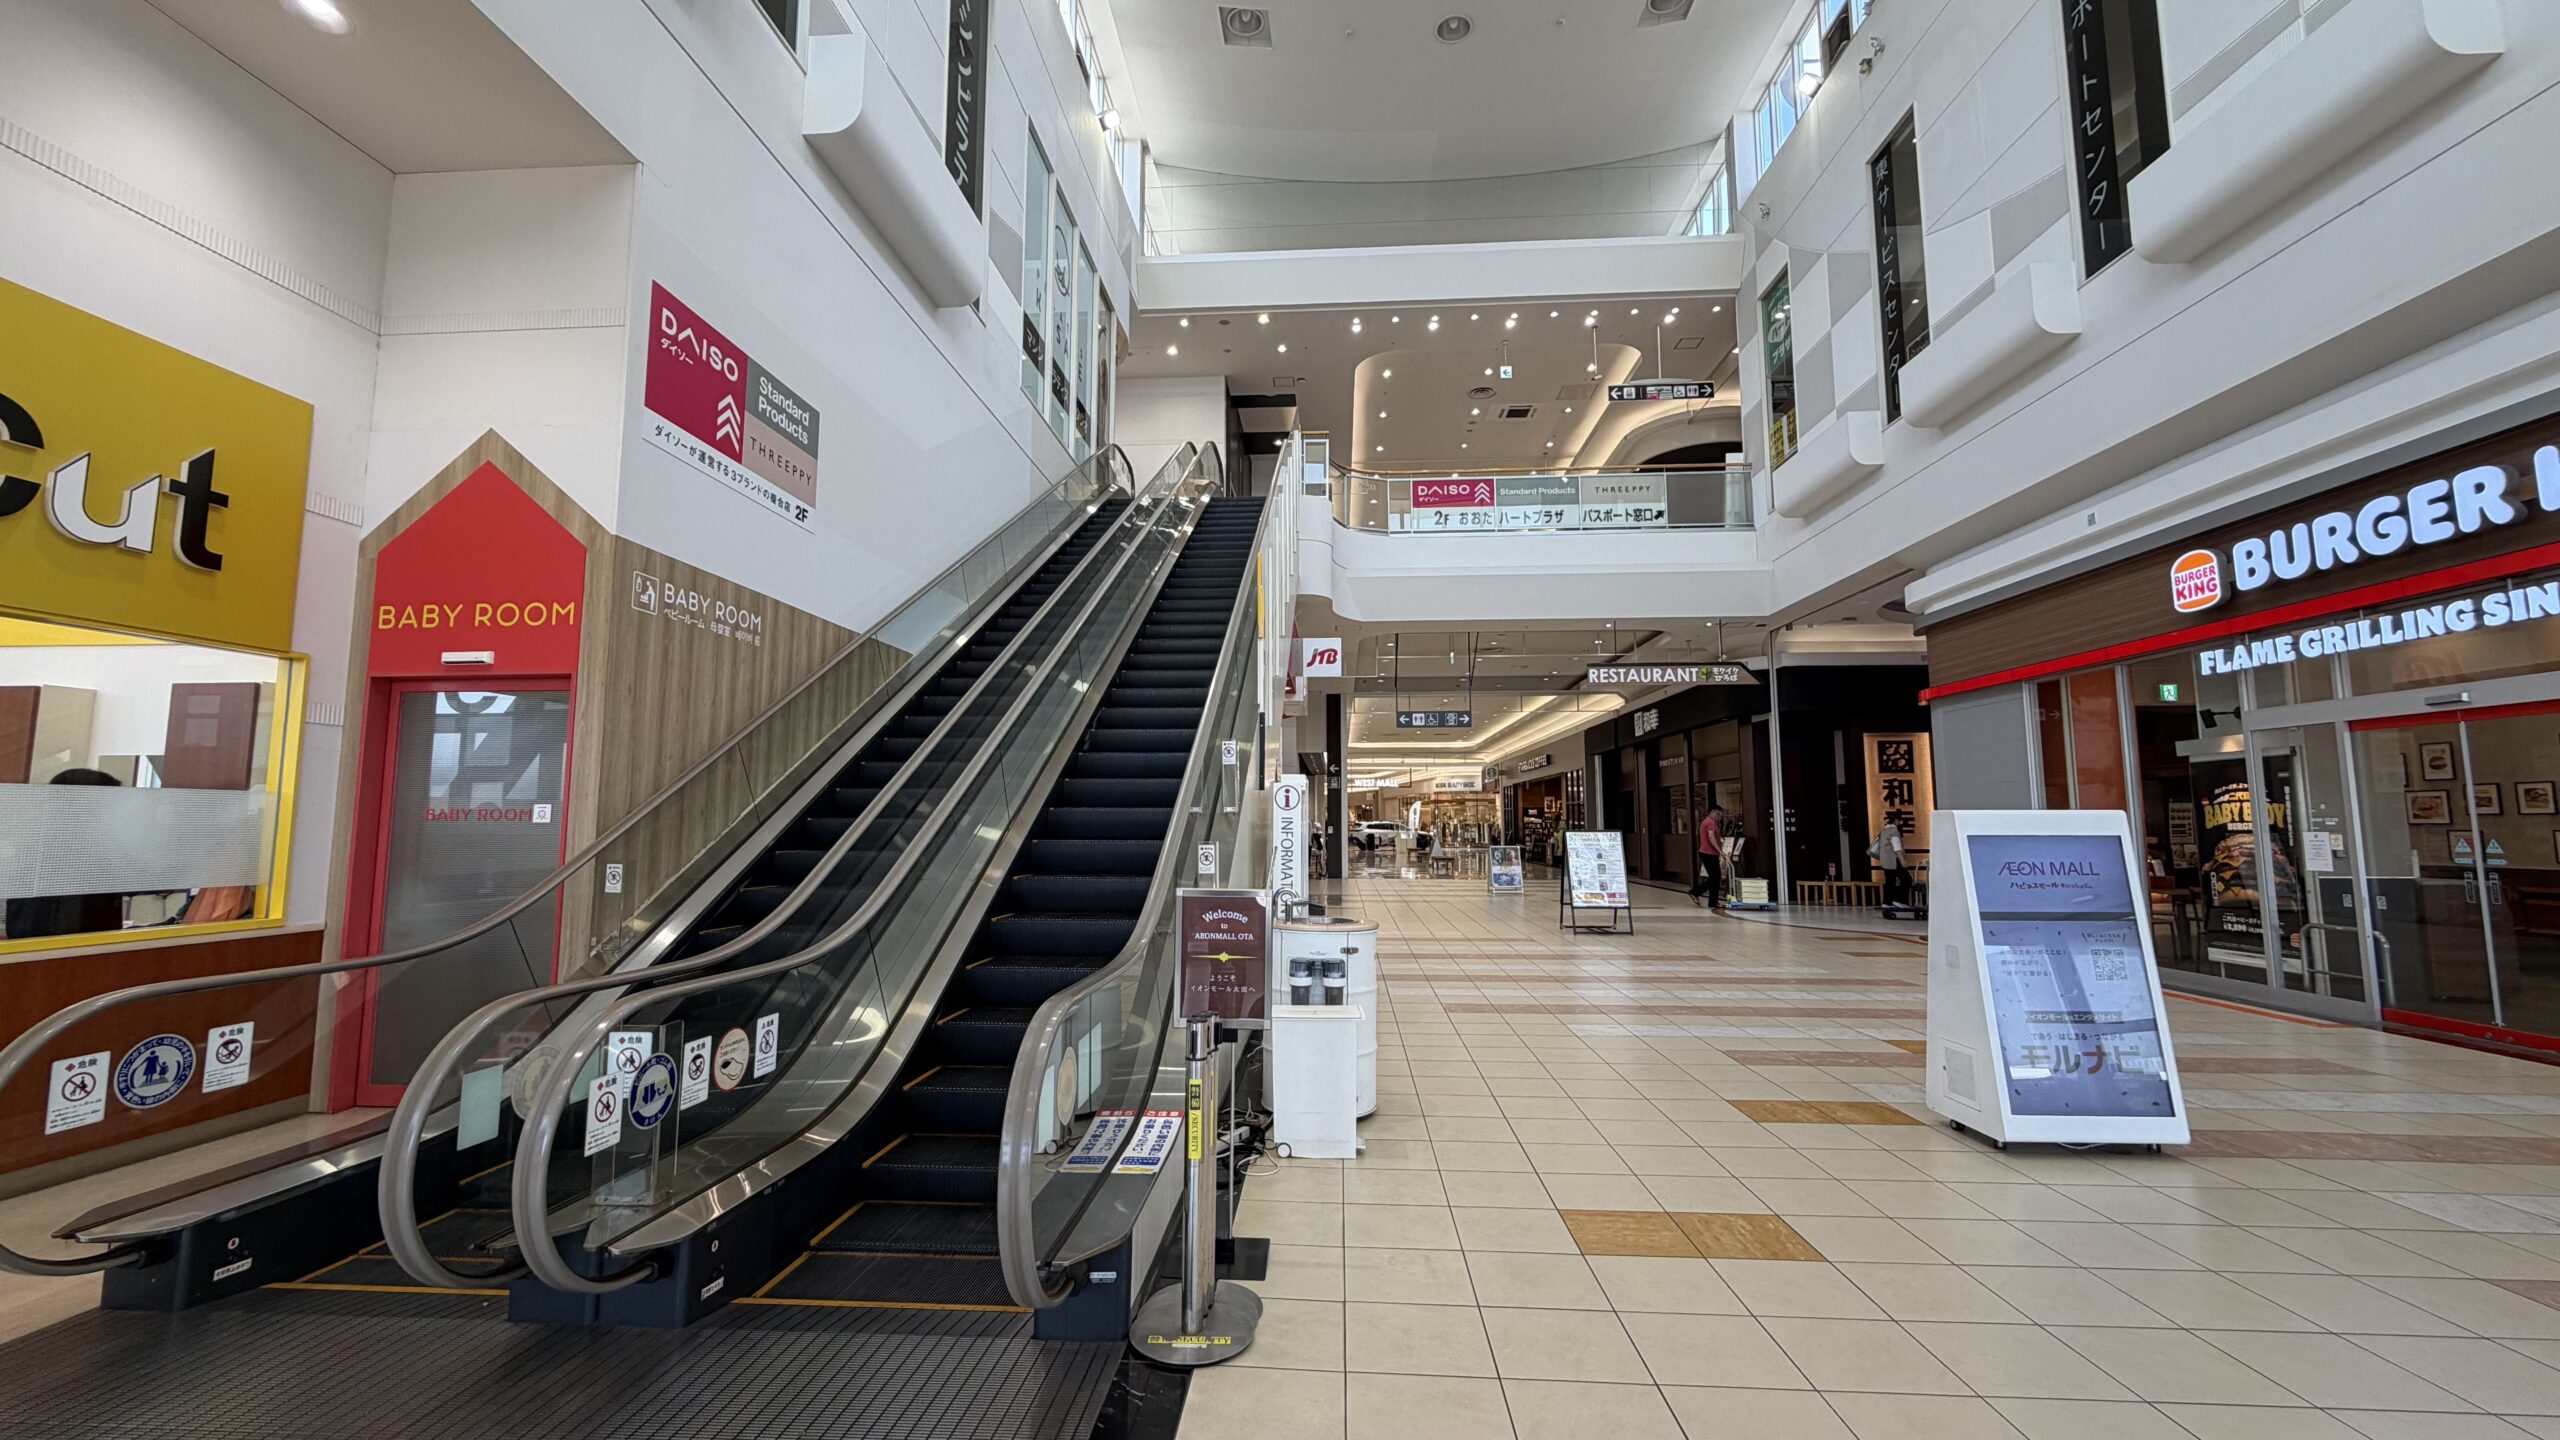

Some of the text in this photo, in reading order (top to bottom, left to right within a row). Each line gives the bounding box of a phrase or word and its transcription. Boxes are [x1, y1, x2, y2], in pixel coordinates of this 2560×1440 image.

[953, 0, 973, 186] シンピラテ
[1876, 157, 1899, 404] 東サービスセンター
[661, 307, 738, 382] DAISO
[661, 337, 694, 365] ダイソー
[759, 376, 809, 427] Standard
[758, 395, 808, 445] Products
[750, 436, 812, 486] THREEPPY
[1417, 484, 1470, 496] DAISO
[1500, 486, 1576, 496] Standard Products
[1595, 485, 1651, 493] THREEPPY
[795, 505, 808, 523] 2F
[1433, 510, 1450, 526] 2F
[1459, 510, 1493, 526] おおた
[1499, 509, 1564, 525] ハートプラザ
[2232, 465, 2514, 591] BURGER
[2174, 564, 2216, 587] BURGER
[2175, 576, 2218, 602] KING
[378, 601, 576, 629] BABY ROOM
[664, 583, 762, 632] BABY ROOM
[664, 608, 705, 629] ベビールーム
[2200, 635, 2296, 676] FLAME
[2300, 598, 2477, 658] GRILLING
[1306, 648, 1339, 668] JTB
[1589, 667, 1699, 683] RESTAURANT
[1354, 778, 1399, 787] WEST MALL
[424, 807, 532, 822] BABY ROOM
[2204, 803, 2241, 829] BABY
[2243, 803, 2286, 829] BDY
[2050, 862, 2100, 876] MALL
[1202, 909, 1248, 923] Welcome
[1220, 922, 1229, 930] to
[1195, 932, 1254, 940] AEONMALL OTA
[1210, 974, 1236, 982] ようこそ
[1191, 985, 1256, 993] イオンモール太田へ
